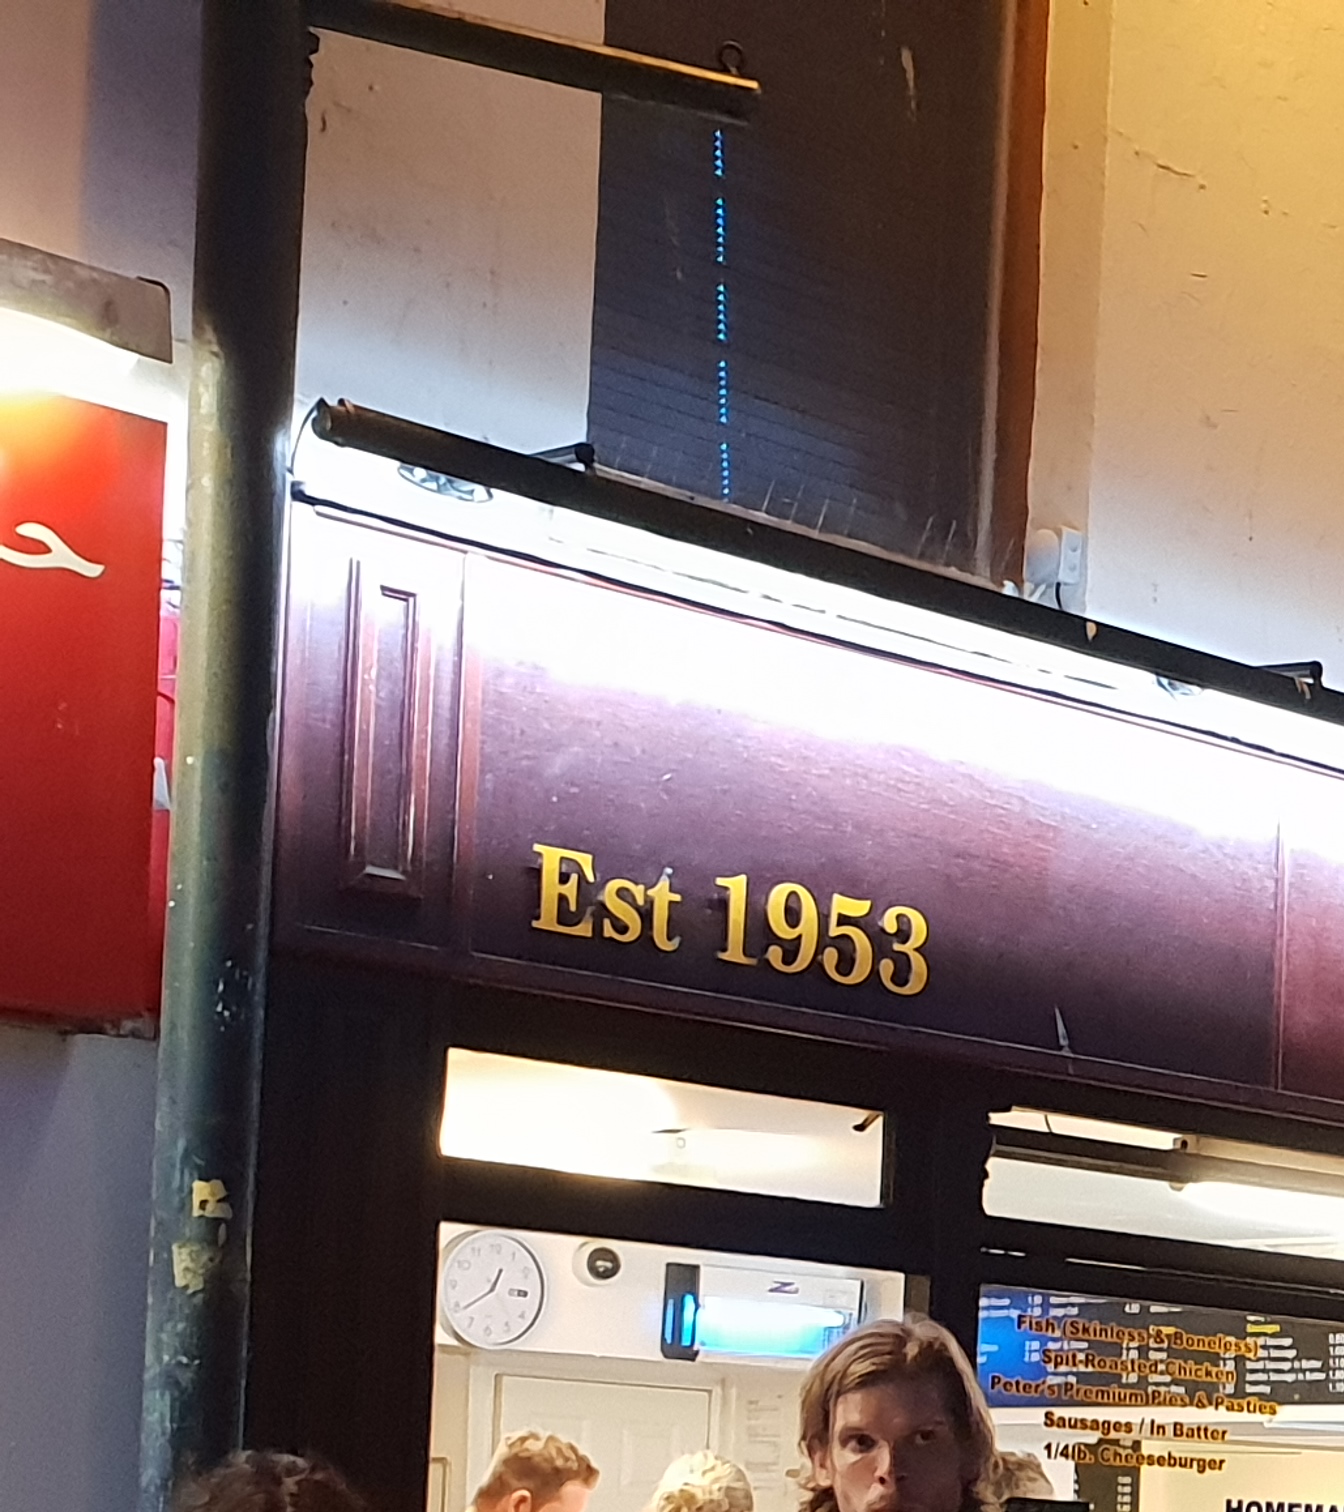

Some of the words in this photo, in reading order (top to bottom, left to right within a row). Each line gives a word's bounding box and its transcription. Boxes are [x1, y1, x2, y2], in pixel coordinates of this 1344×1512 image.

[532, 843, 682, 952] Est
[714, 873, 929, 996] 1953
[1016, 1314, 1056, 1335] Fish
[1062, 1319, 1148, 1345] (Skinless
[1173, 1331, 1261, 1358] Boneless)
[1041, 1348, 1160, 1375] Spit-Roasted
[1165, 1359, 1236, 1383] Chicken
[990, 1374, 1057, 1396] Peter's
[1063, 1380, 1145, 1405] Premium
[1151, 1389, 1190, 1408] Pies
[1214, 1394, 1278, 1416] Pasties
[1043, 1411, 1134, 1436] Sausages
[1138, 1417, 1146, 1435] /
[1149, 1420, 1167, 1437] In
[1173, 1421, 1228, 1442] Batter
[1099, 1446, 1227, 1474] Cheeseburger
